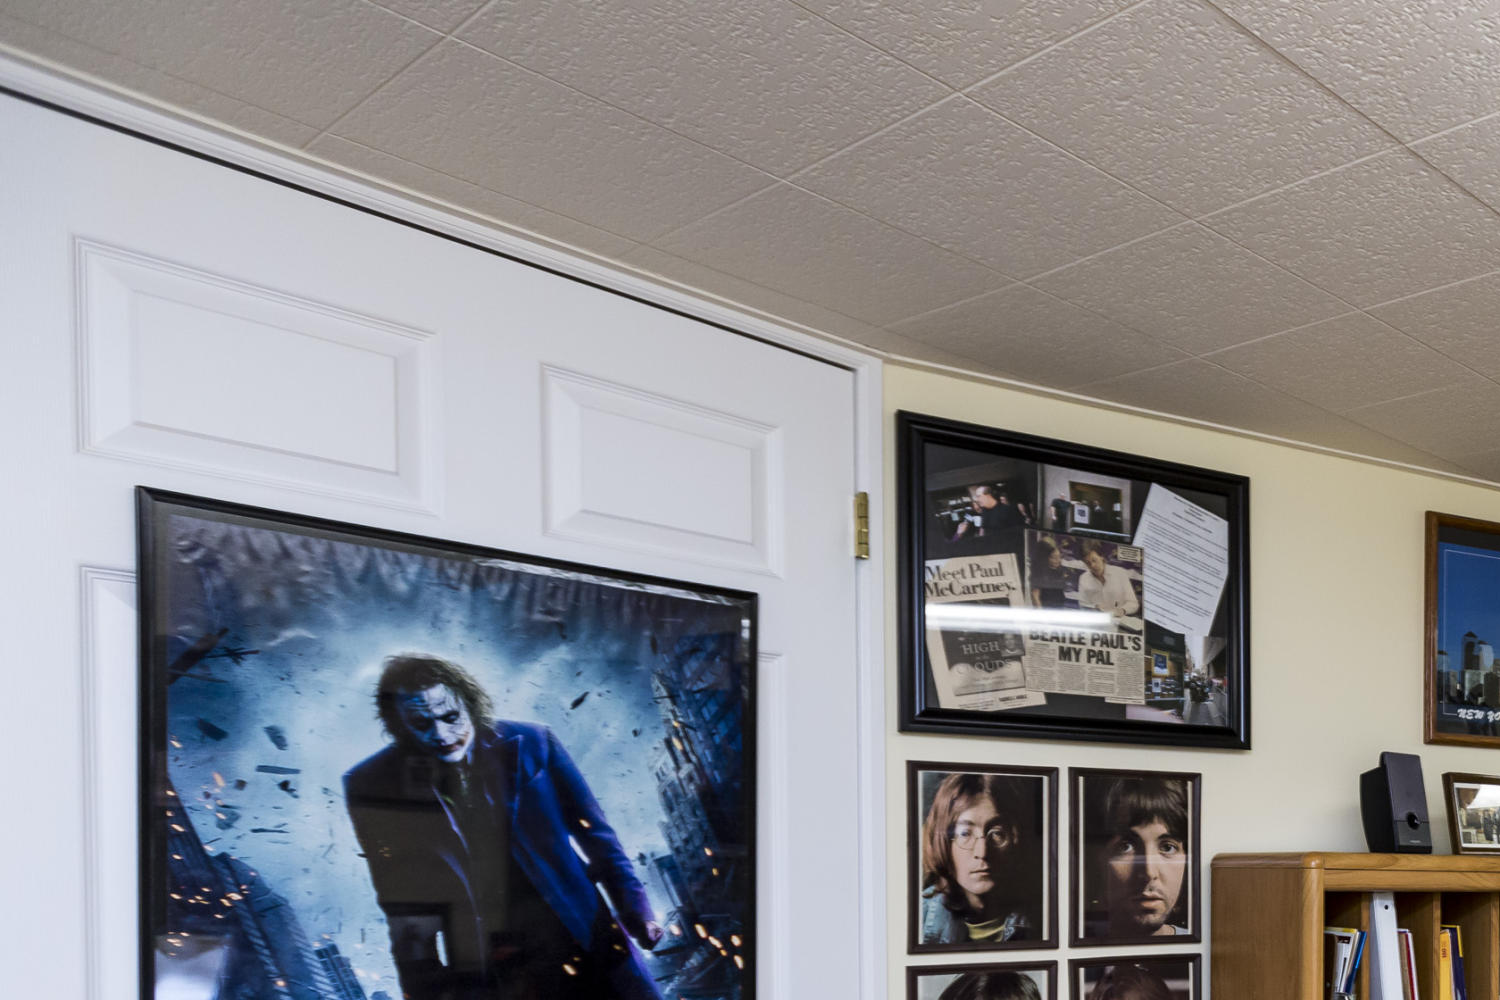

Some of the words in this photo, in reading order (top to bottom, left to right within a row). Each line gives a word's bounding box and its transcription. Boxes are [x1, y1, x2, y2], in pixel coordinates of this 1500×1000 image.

[925, 564, 966, 581] Meet
[968, 561, 1004, 579] Paul
[924, 579, 1016, 598] McCartney.
[962, 641, 1000, 655] HIGH
[1090, 632, 1142, 651] PAUL'S
[1058, 645, 1082, 663] MY
[1086, 648, 1114, 666] PAL
[1457, 708, 1484, 720] NEW
